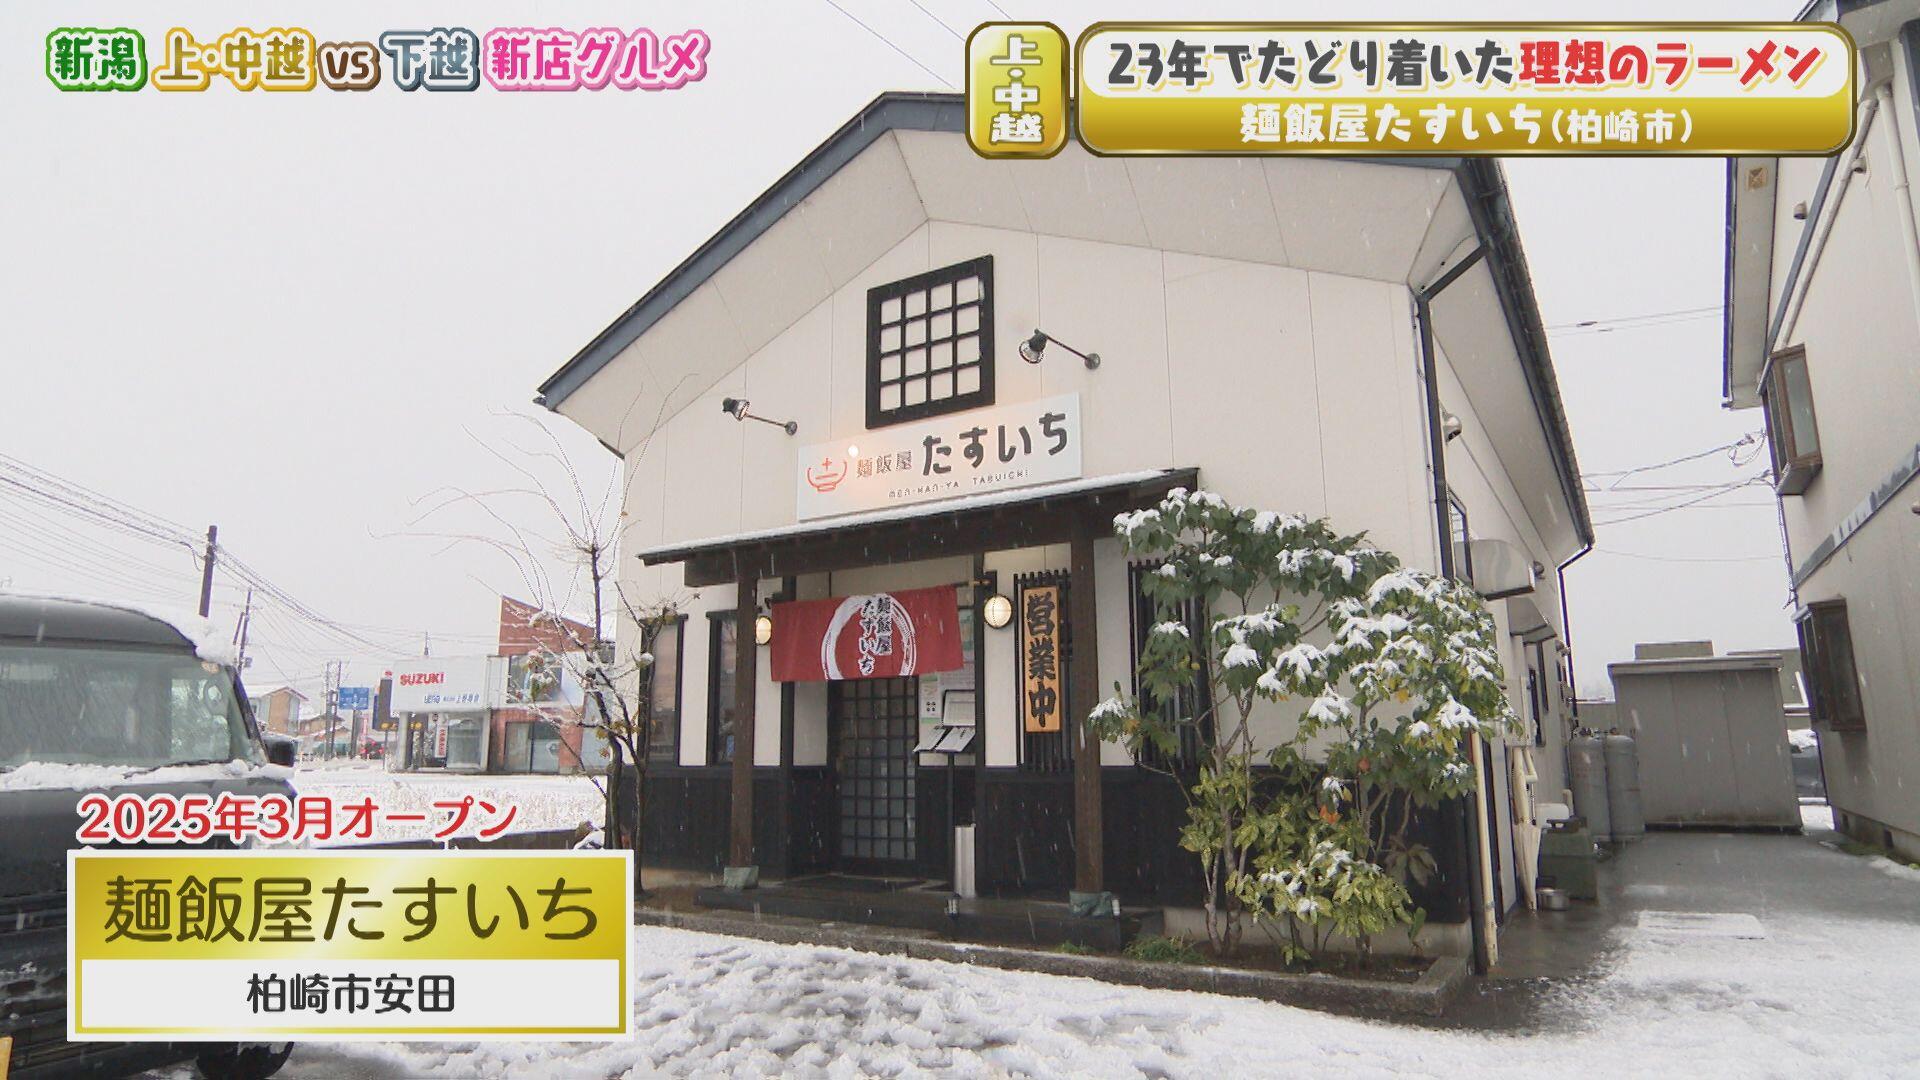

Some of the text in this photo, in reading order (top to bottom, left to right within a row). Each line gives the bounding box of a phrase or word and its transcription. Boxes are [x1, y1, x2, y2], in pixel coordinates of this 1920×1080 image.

[922, 411, 1068, 477] たすいち
[399, 671, 446, 687] SUZUKI
[1026, 590, 1057, 728] 営業中
